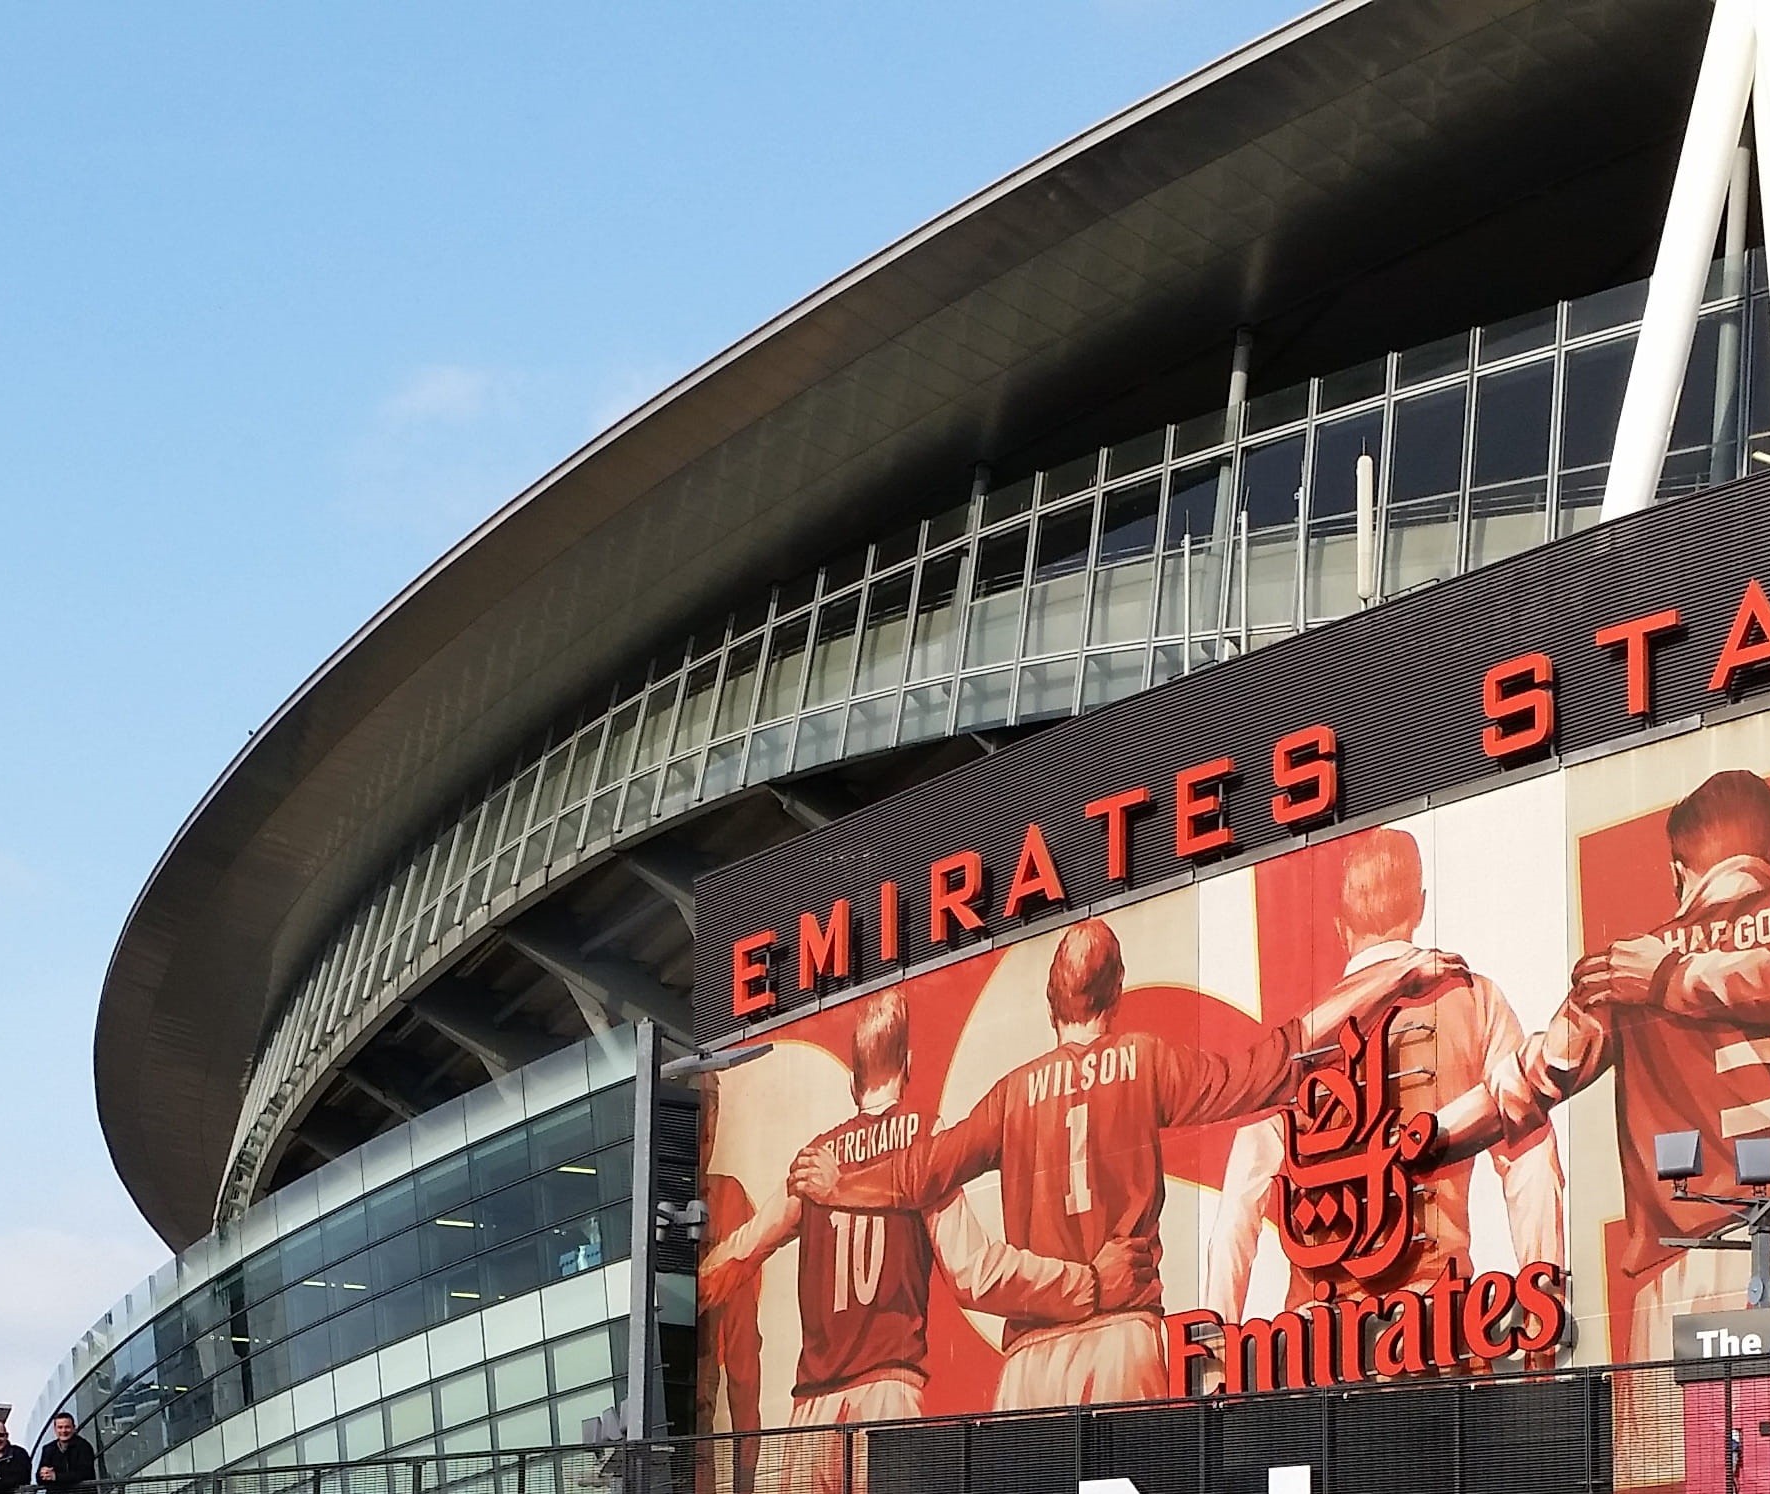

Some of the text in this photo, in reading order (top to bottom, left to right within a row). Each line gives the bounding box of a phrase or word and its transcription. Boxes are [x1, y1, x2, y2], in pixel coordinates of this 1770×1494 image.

[732, 724, 1338, 1017] EMIRATES
[1027, 1044, 1137, 1107] WILSON
[1064, 1103, 1093, 1216] 1
[829, 1211, 886, 1313] 10
[1164, 1262, 1564, 1398] Emirates
[1696, 1328, 1762, 1358] The
